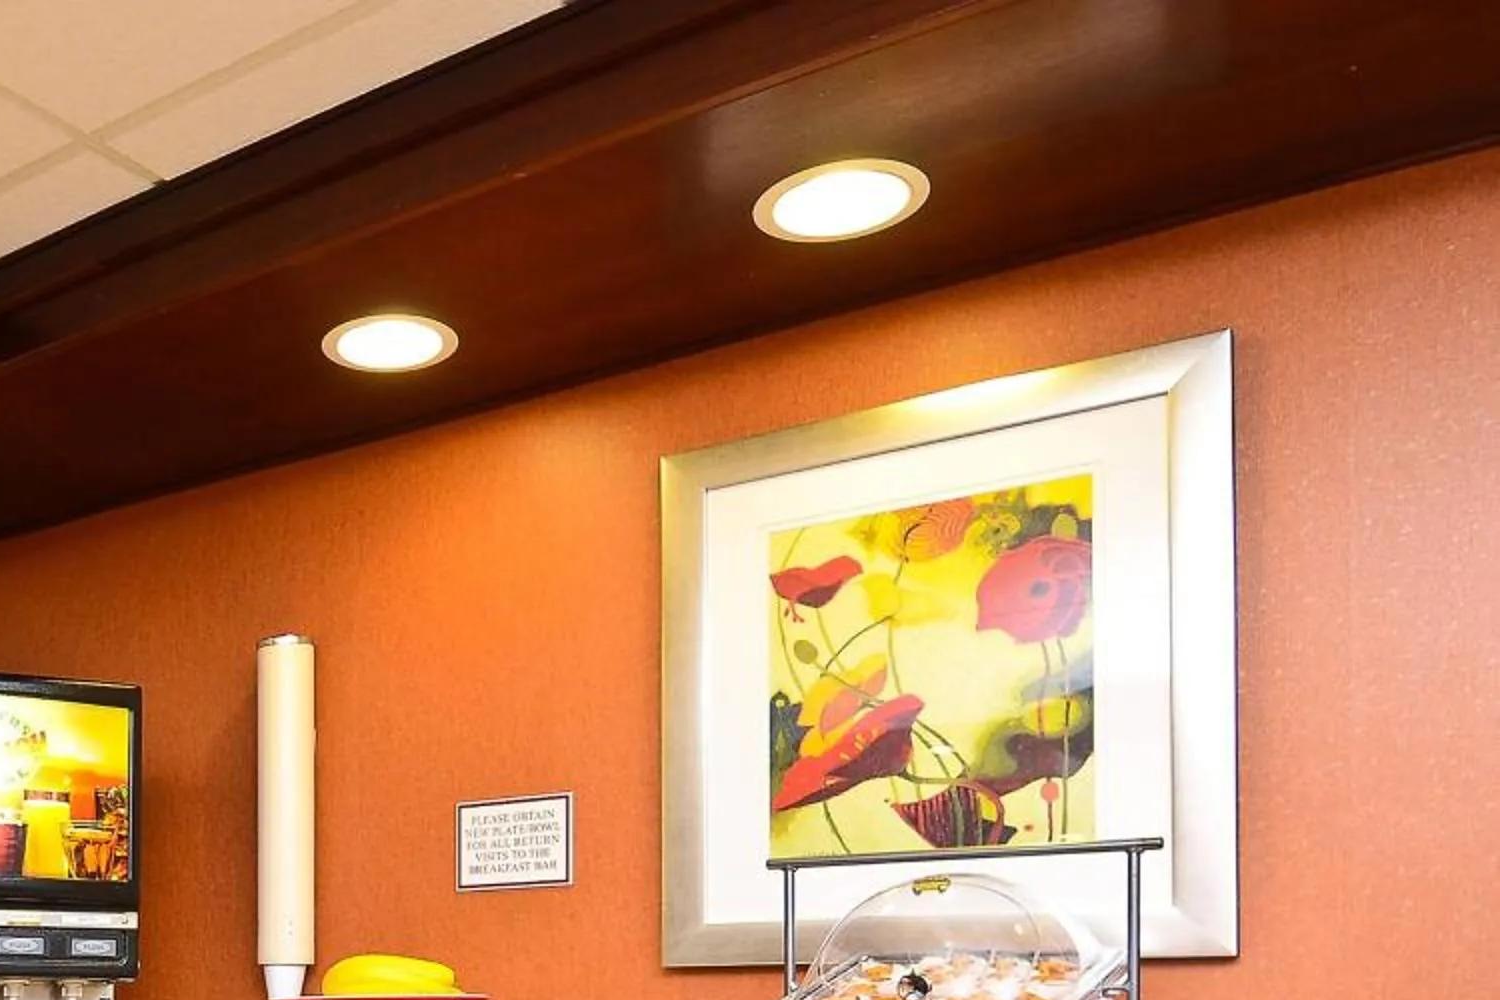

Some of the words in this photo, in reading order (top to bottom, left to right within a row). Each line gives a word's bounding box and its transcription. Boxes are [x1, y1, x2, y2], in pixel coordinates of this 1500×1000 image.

[471, 813, 510, 825] PLEASE
[512, 808, 555, 822] OBTAIN
[464, 826, 489, 838] NEW
[466, 840, 487, 851] FOR
[490, 837, 511, 849] ALL
[513, 834, 560, 848] RETURN
[475, 851, 509, 862] VISITS
[510, 849, 527, 859] TO
[528, 847, 551, 859] THE
[468, 861, 531, 875] BREAKFAST
[533, 859, 557, 872] BAR
